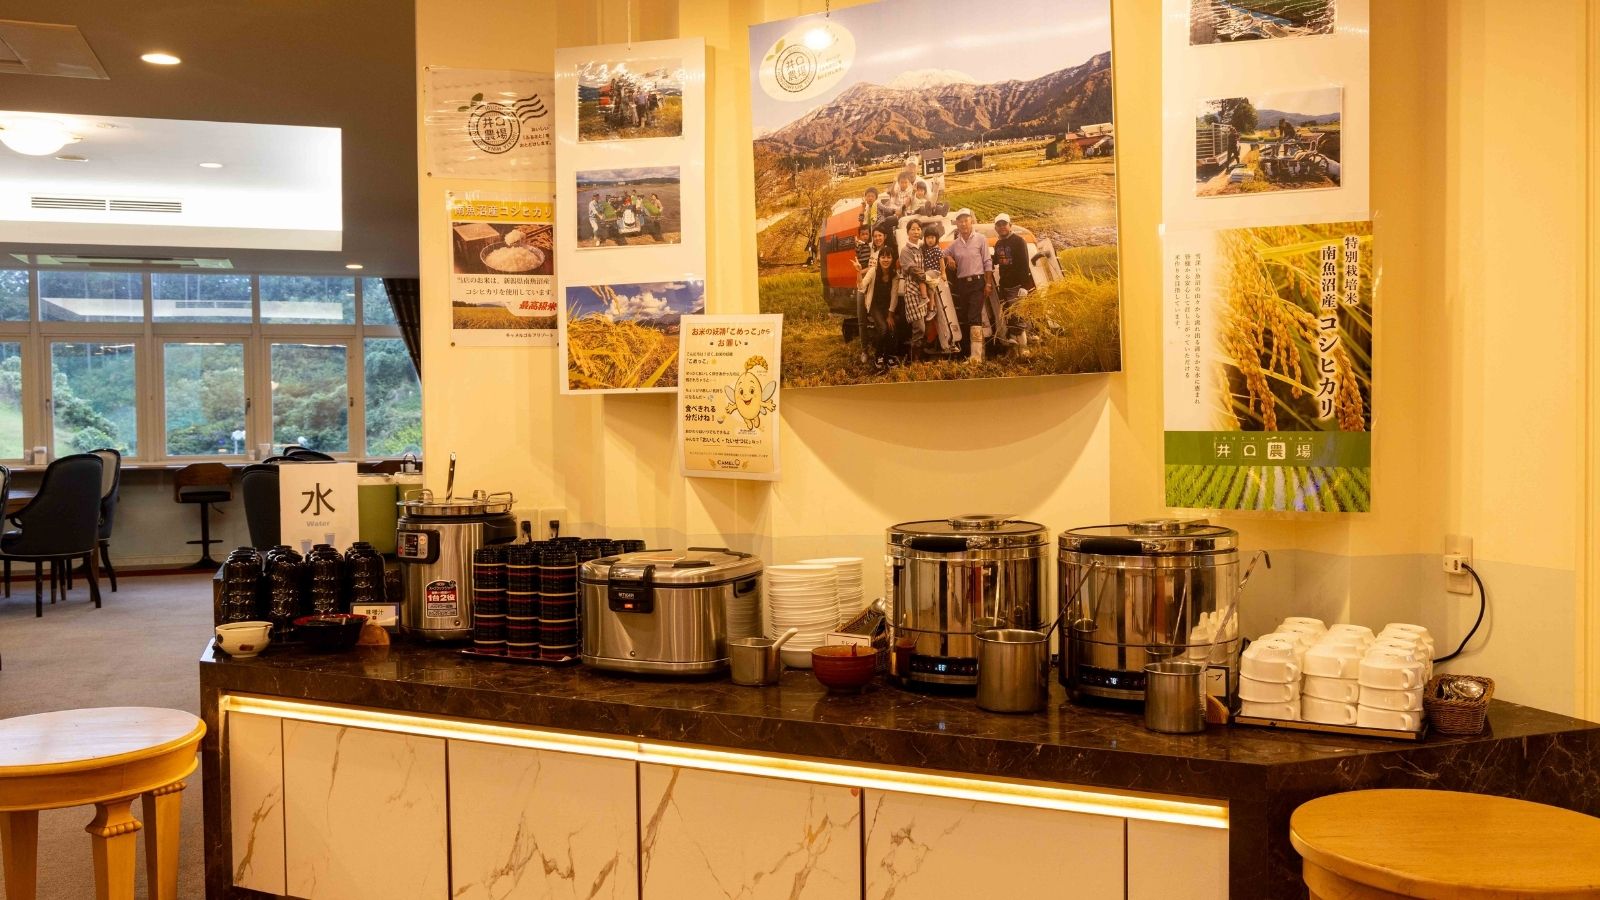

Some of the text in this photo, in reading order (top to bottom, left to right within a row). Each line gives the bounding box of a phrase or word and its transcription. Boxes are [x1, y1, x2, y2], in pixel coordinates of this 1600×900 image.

[455, 204, 552, 218] 南魚沼産コシヒカリ
[1345, 236, 1358, 305] 特別栽培米
[692, 328, 771, 336] お米の妖精「こめっこ」から
[685, 404, 716, 413] 食べきれる
[300, 482, 335, 516] 水
